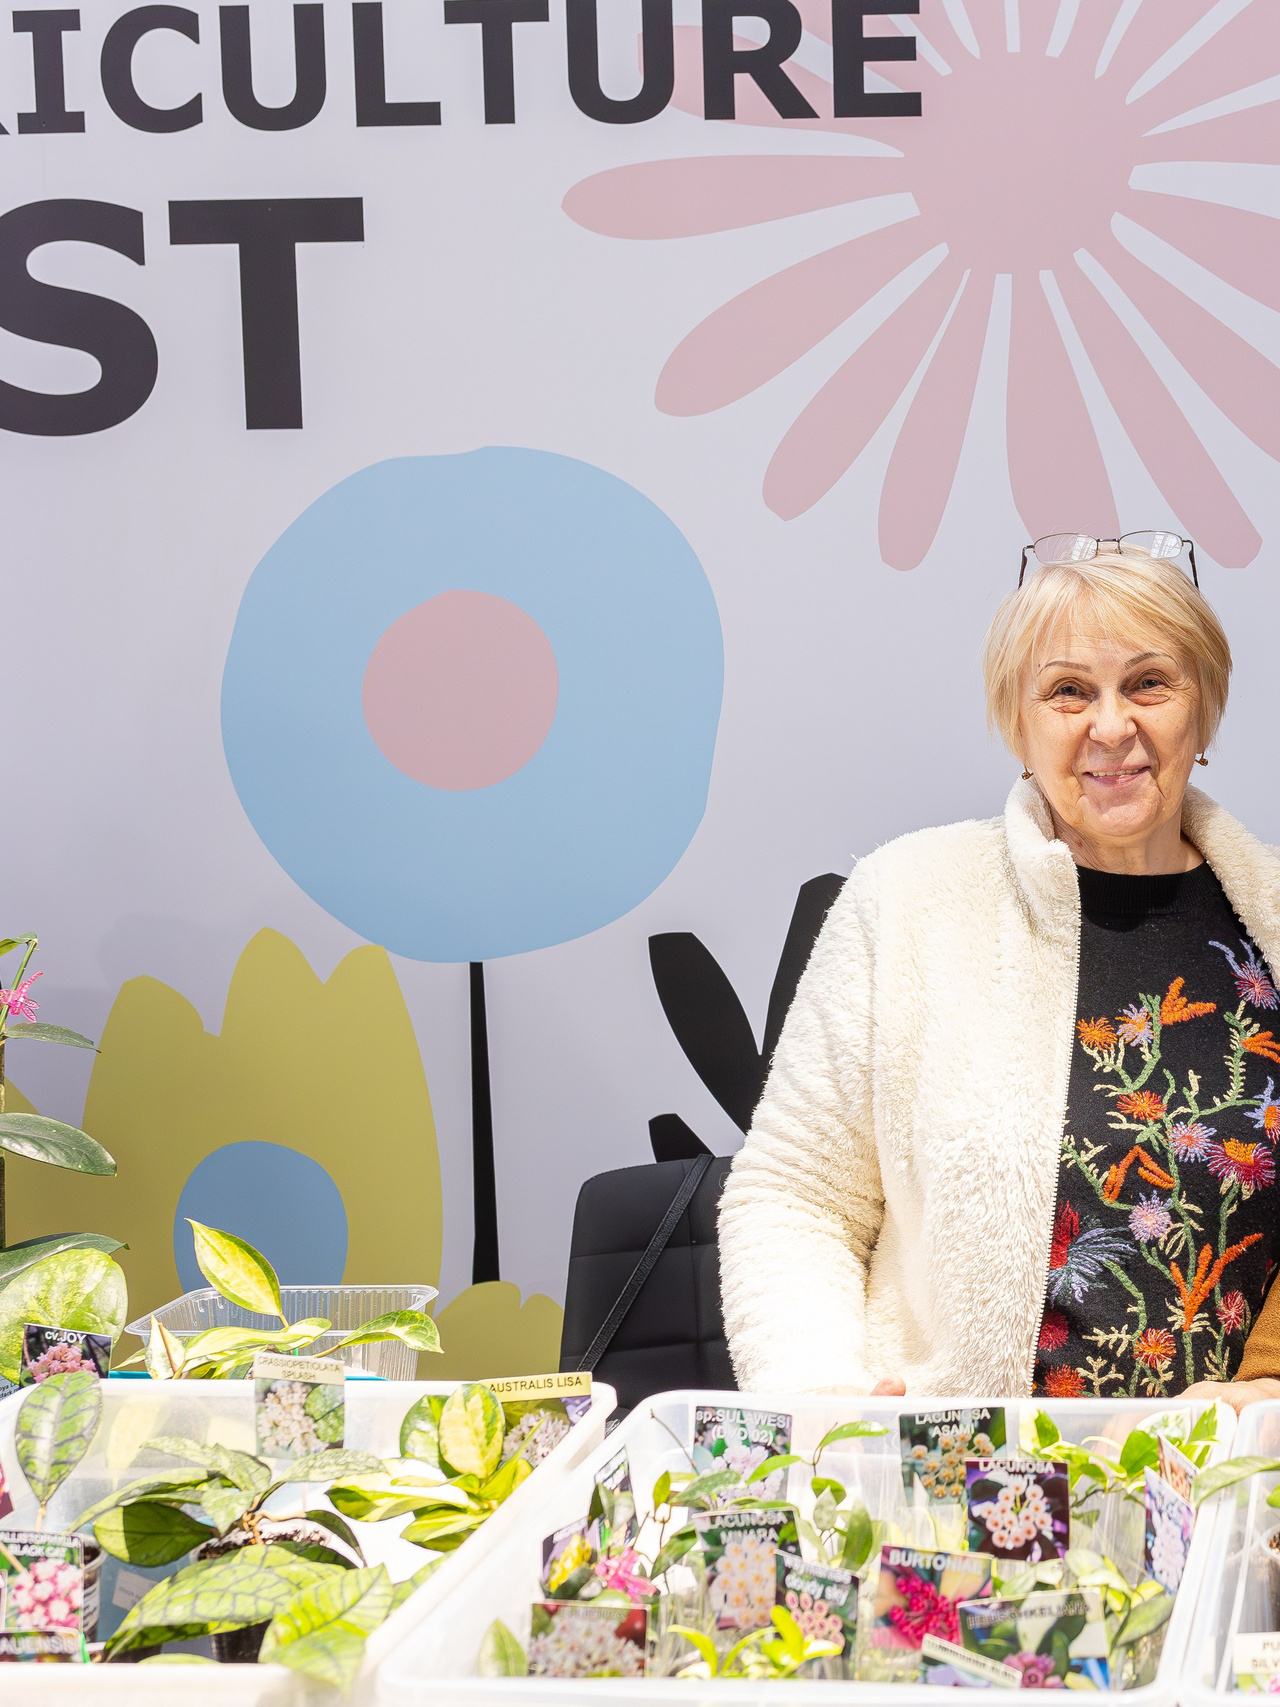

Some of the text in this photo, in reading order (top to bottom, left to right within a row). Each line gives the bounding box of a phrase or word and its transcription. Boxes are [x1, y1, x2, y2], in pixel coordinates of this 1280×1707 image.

[0, 0, 922, 136] ICULTURE
[0, 197, 365, 436] ST
[44, 1331, 87, 1344] cv.JOY
[489, 1376, 583, 1394] AUSTRALIS LISA
[914, 1408, 991, 1425] LACUNOSA
[931, 1423, 975, 1438] ASAMI
[979, 1460, 1056, 1475] LACUNOSA
[708, 1511, 789, 1529] LACUNOSA
[888, 1549, 984, 1575] BURTONIAE
